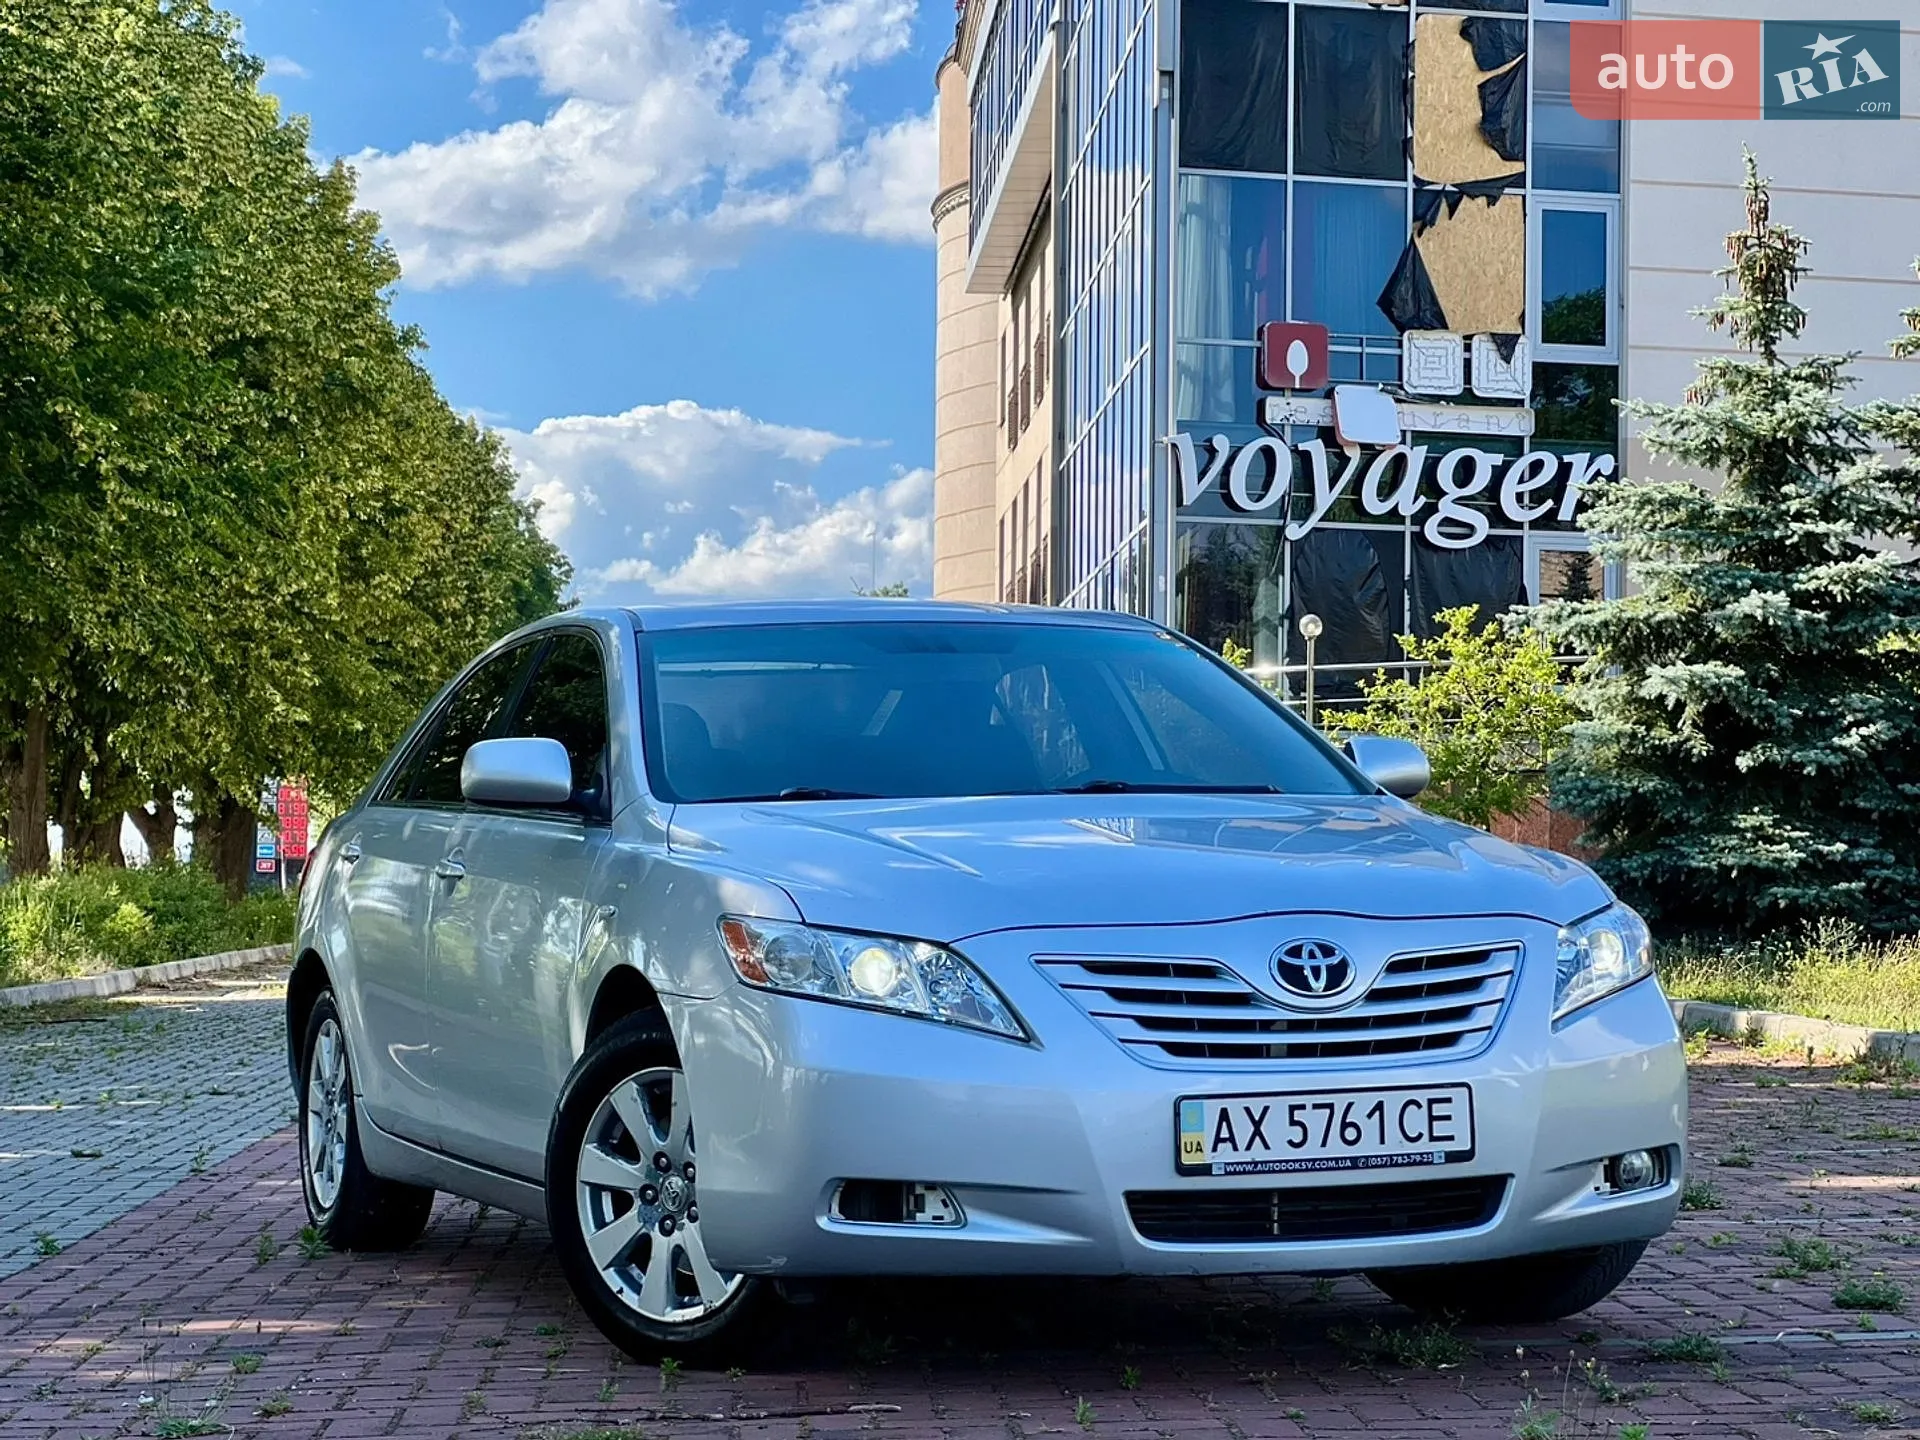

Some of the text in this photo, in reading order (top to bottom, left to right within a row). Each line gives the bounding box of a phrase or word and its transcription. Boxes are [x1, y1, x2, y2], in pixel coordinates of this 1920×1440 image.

[1166, 432, 1616, 549] voyager
[1183, 1140, 1204, 1154] UA
[1211, 1096, 1455, 1153] AX 5761 CE
